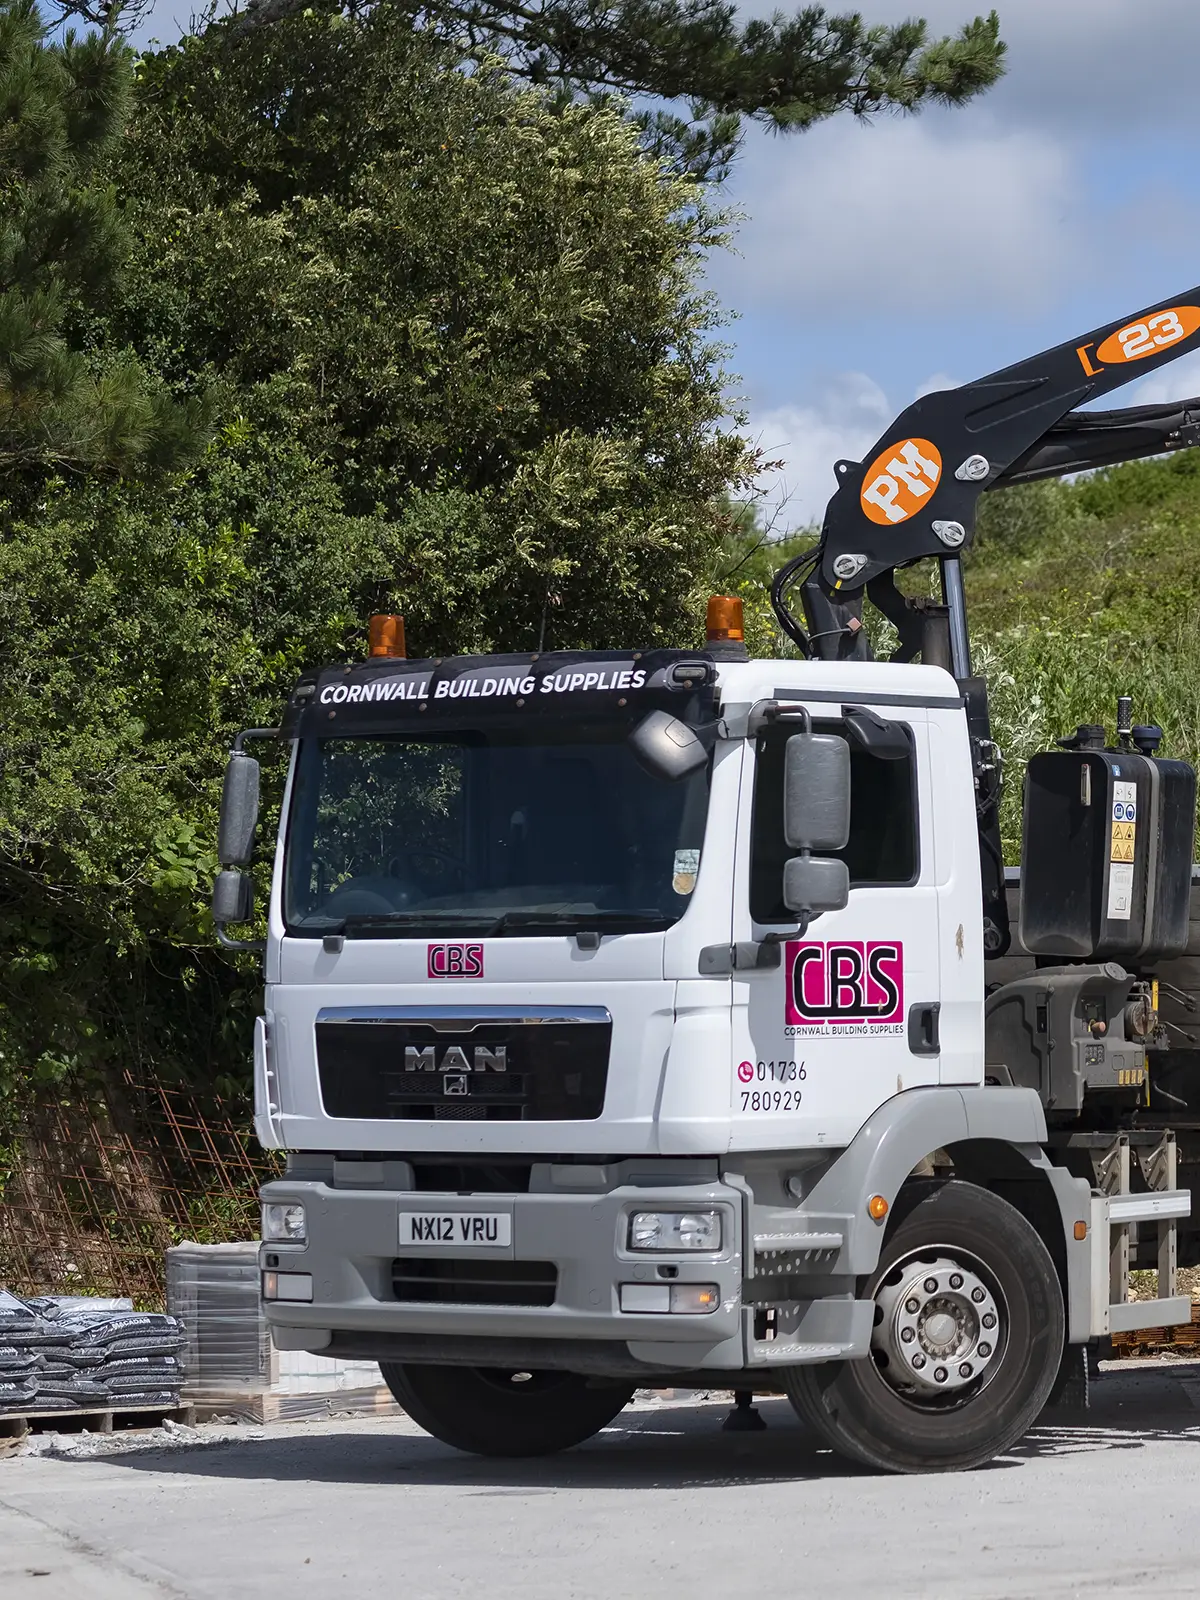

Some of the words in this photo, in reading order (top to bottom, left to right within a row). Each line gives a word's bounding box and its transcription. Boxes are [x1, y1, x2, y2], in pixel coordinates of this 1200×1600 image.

[862, 440, 940, 523] PM
[320, 681, 429, 704] CORNWALL
[434, 677, 535, 699] BUILDING
[540, 670, 646, 693] SUPPLIES
[428, 945, 482, 977] CBS
[793, 946, 899, 1018] CBS
[784, 1027, 830, 1036] CORNWALL
[831, 1026, 868, 1035] BUILDING
[869, 1025, 904, 1034] SUPPLIES
[404, 1046, 507, 1072] MAN
[756, 1061, 807, 1081] 01736
[740, 1090, 802, 1112] 780929
[411, 1217, 454, 1241] NX12
[460, 1217, 498, 1241] VRU
